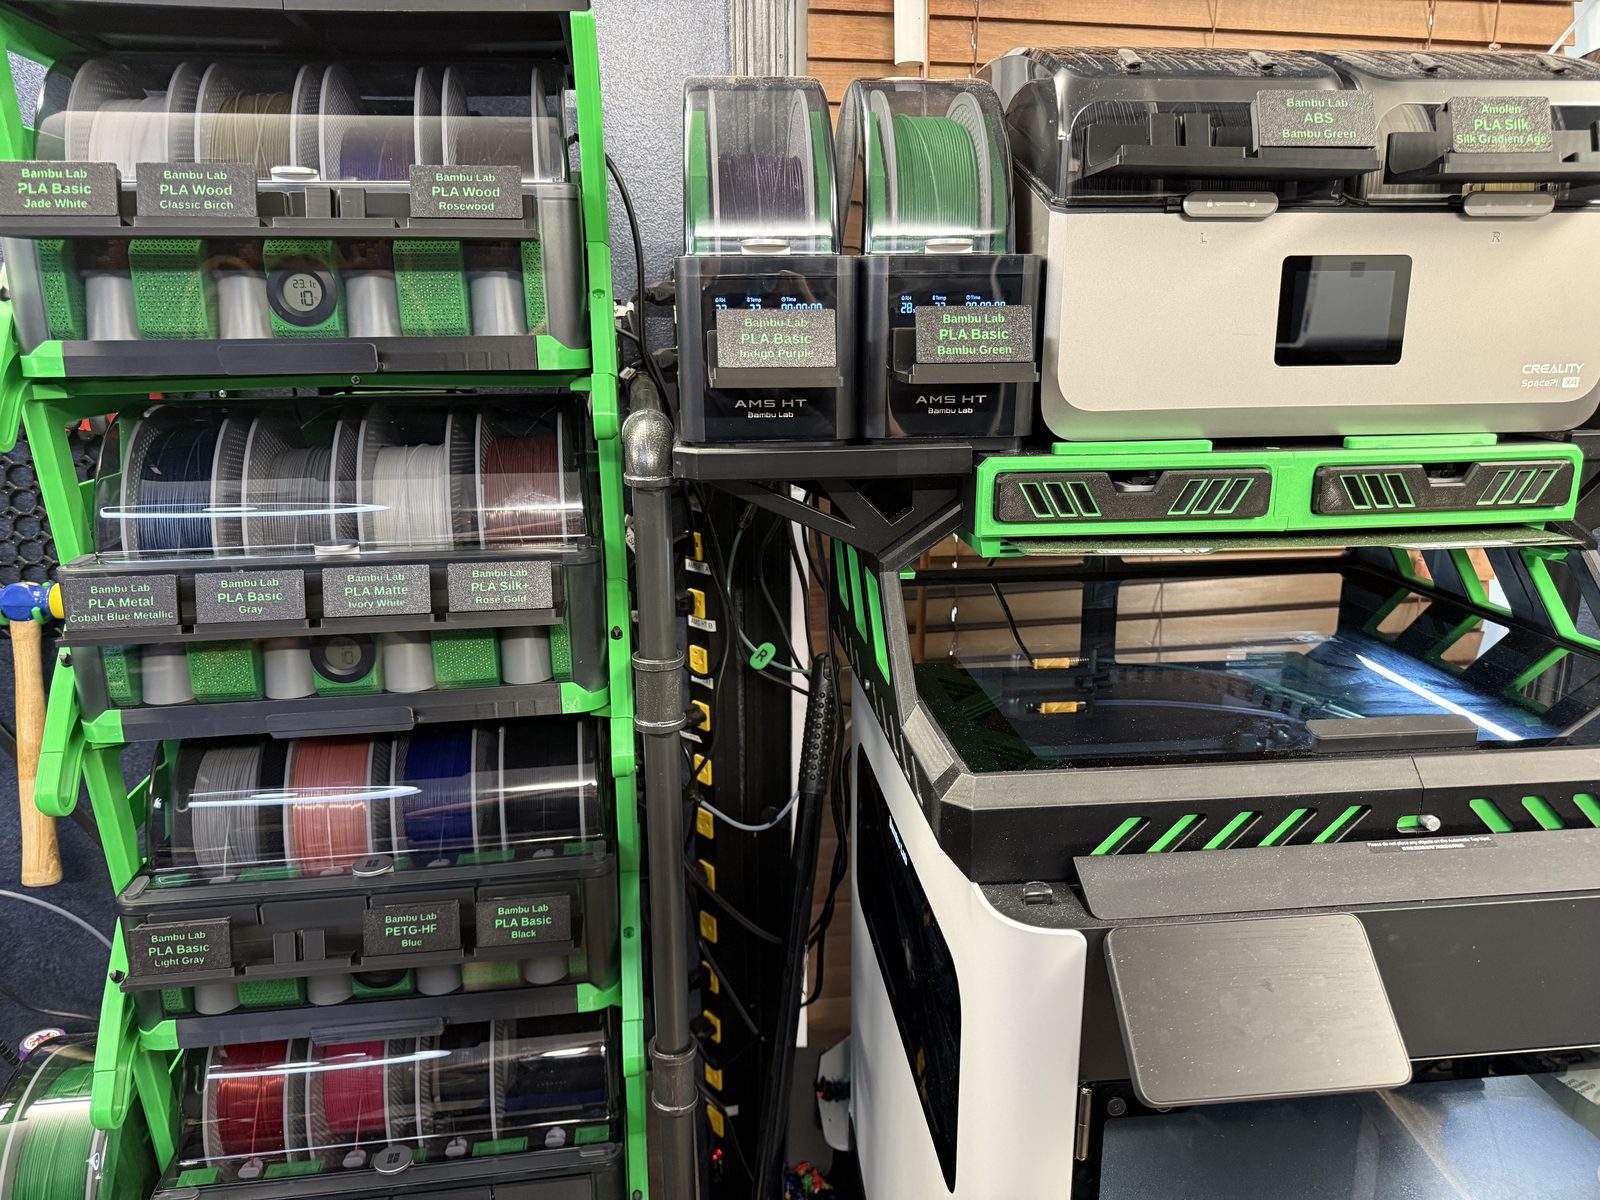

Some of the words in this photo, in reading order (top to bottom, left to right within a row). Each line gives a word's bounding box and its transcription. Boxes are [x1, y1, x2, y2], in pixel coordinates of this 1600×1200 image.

[1286, 98, 1325, 107] Bambu
[1328, 98, 1348, 107] Lab
[1304, 113, 1334, 123] ABS
[1474, 119, 1501, 131] PLA
[1505, 119, 1530, 130] Silk
[1282, 129, 1320, 138] Bambu
[1324, 129, 1357, 138] Green
[1456, 134, 1476, 144] Silk
[1479, 134, 1523, 144] Gradient
[1526, 134, 1547, 145] Age
[21, 169, 62, 179] Bambu
[66, 169, 87, 179] Lab
[164, 170, 203, 180] Bambu
[206, 170, 227, 180] Lab
[436, 173, 473, 182] Bambu
[476, 174, 495, 182] Lab
[18, 183, 47, 195] PLA
[52, 183, 91, 195] Basic
[159, 184, 188, 196] PLA
[192, 184, 232, 196] Wood
[432, 186, 459, 197] PLA
[462, 187, 500, 197] Wood
[24, 199, 51, 208] Jade
[54, 199, 87, 208] White
[159, 200, 201, 209] Classic
[204, 200, 234, 210] Birch
[439, 201, 495, 210] Rosewood
[1492, 231, 1501, 243] R
[744, 318, 784, 327] Bambu
[788, 318, 808, 327] Lab
[943, 314, 981, 324] Bambu
[985, 314, 1005, 323] Lab
[741, 333, 770, 344] PLA
[774, 333, 813, 344] Basic
[939, 329, 968, 340] PLA
[971, 329, 1009, 340] Basic
[740, 350, 775, 360] Indigo
[778, 350, 814, 360] Purple
[937, 346, 976, 355] Bambu
[979, 345, 1012, 354] Green
[1522, 363, 1585, 374] CREALITY
[1565, 378, 1577, 386] X4
[734, 399, 776, 408] AMS
[782, 399, 807, 407] HT
[916, 395, 956, 404] AMS
[962, 395, 987, 403] HT
[347, 574, 383, 583] Bambu
[385, 572, 405, 581] Lab
[472, 569, 505, 578] Bambu
[510, 568, 528, 577] Lab
[220, 579, 256, 589] Bambu
[260, 578, 279, 587] Lab
[471, 583, 496, 592] PLA
[500, 582, 529, 591] Silk+
[90, 584, 127, 594] Bambu
[131, 584, 151, 593] Lab
[345, 587, 370, 597] PLA
[374, 586, 408, 595] Matte
[218, 593, 244, 603] PLA
[248, 591, 283, 602] Basic
[475, 596, 500, 604] Rose
[503, 595, 528, 603] Gold
[88, 599, 116, 609] PLA
[119, 596, 154, 608] Metal
[348, 600, 373, 609] Ivory
[376, 599, 405, 607] White
[239, 605, 263, 615] Gray
[69, 613, 104, 623] Cobalt
[107, 612, 131, 621] Blue
[134, 610, 174, 620] Metallic
[755, 648, 769, 662] R
[497, 906, 530, 915] Bambu
[532, 904, 549, 913] Lab
[385, 914, 417, 923] Bambu
[420, 912, 437, 921] Lab
[495, 918, 518, 928] PLA
[522, 916, 552, 927] Basic
[385, 924, 437, 937] PETG-HF
[511, 930, 536, 939] Black
[151, 933, 185, 943] Bambu
[188, 931, 206, 940] Lab
[401, 939, 422, 947] Blue
[149, 946, 173, 956] PLA
[176, 944, 210, 954] Basic
[154, 958, 179, 968] Light
[182, 956, 205, 965] Gray
